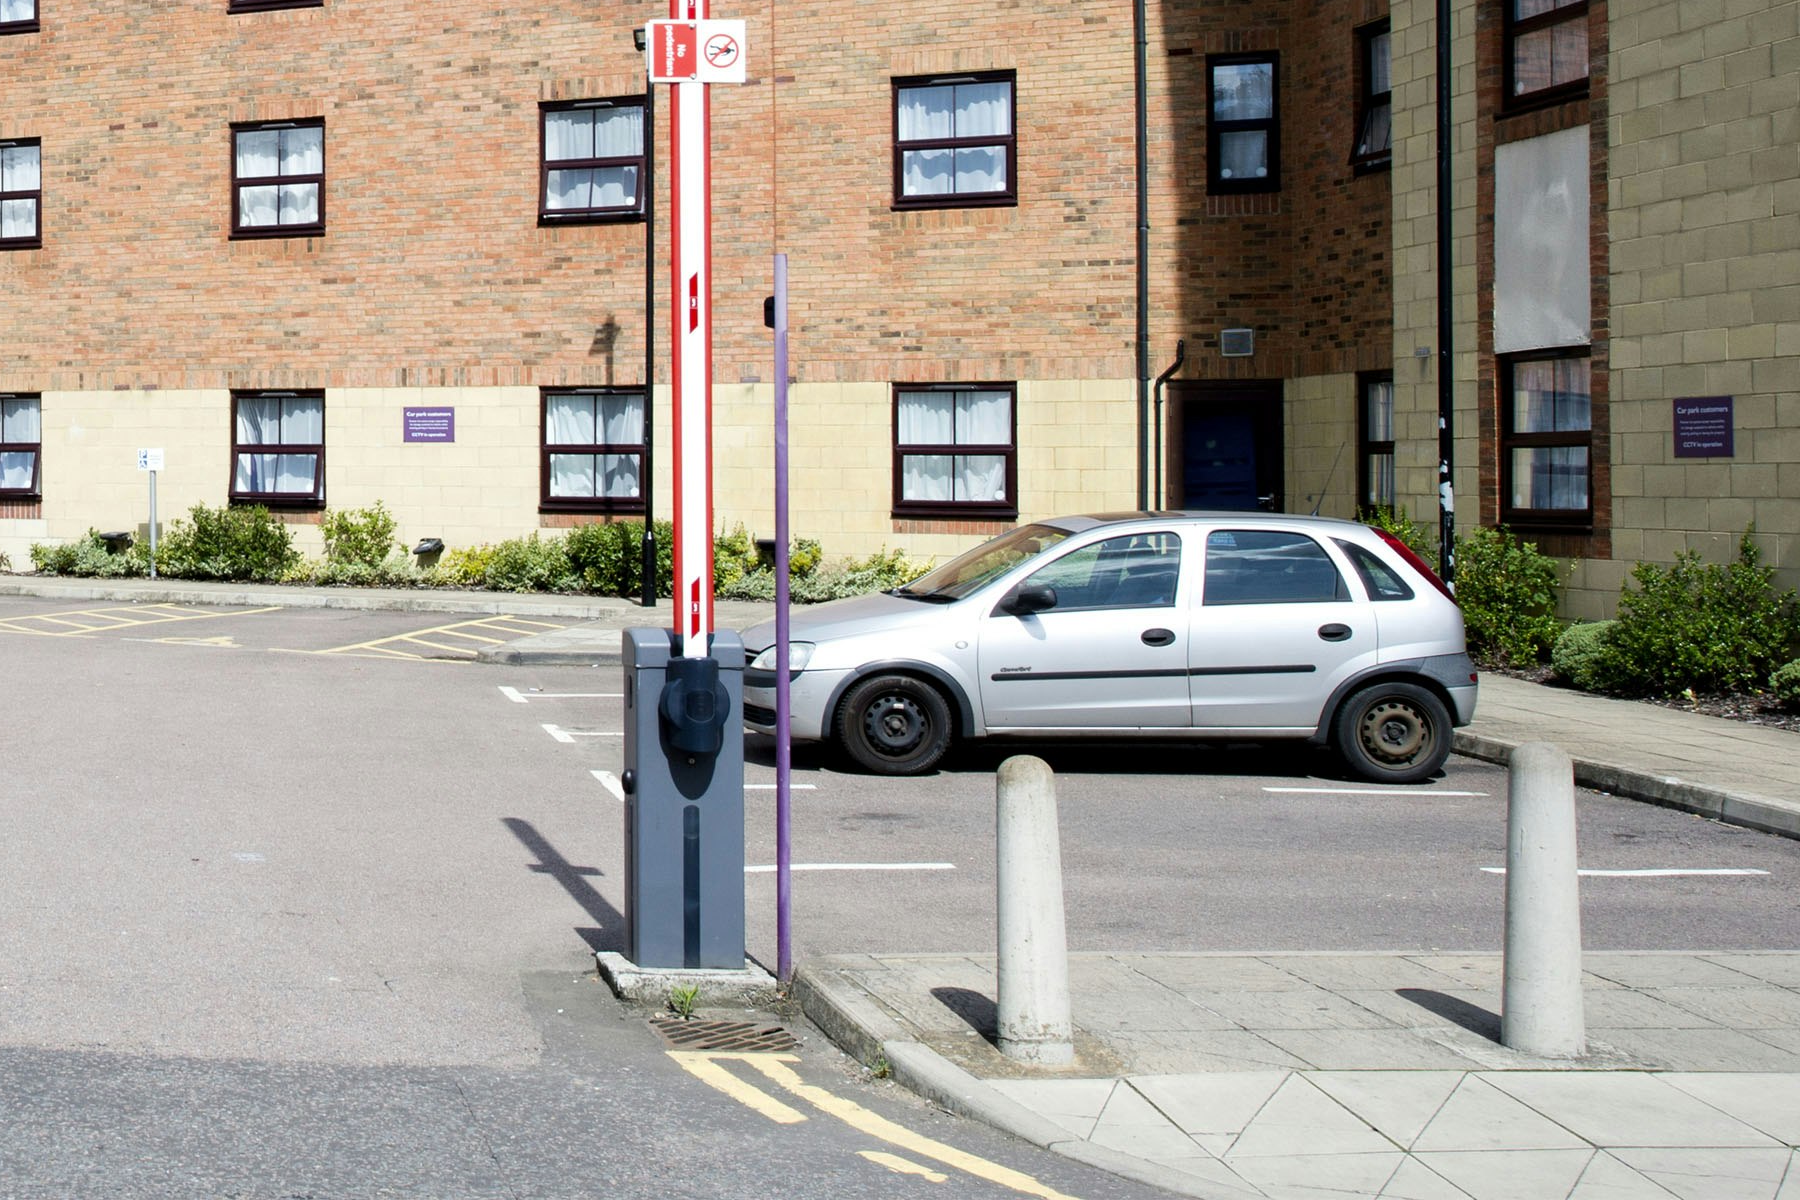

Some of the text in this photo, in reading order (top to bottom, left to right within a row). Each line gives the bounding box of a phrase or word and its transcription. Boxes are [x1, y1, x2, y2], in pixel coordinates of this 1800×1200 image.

[664, 25, 675, 76] pedestrians
[677, 43, 687, 57] No
[1687, 406, 1699, 415] park
